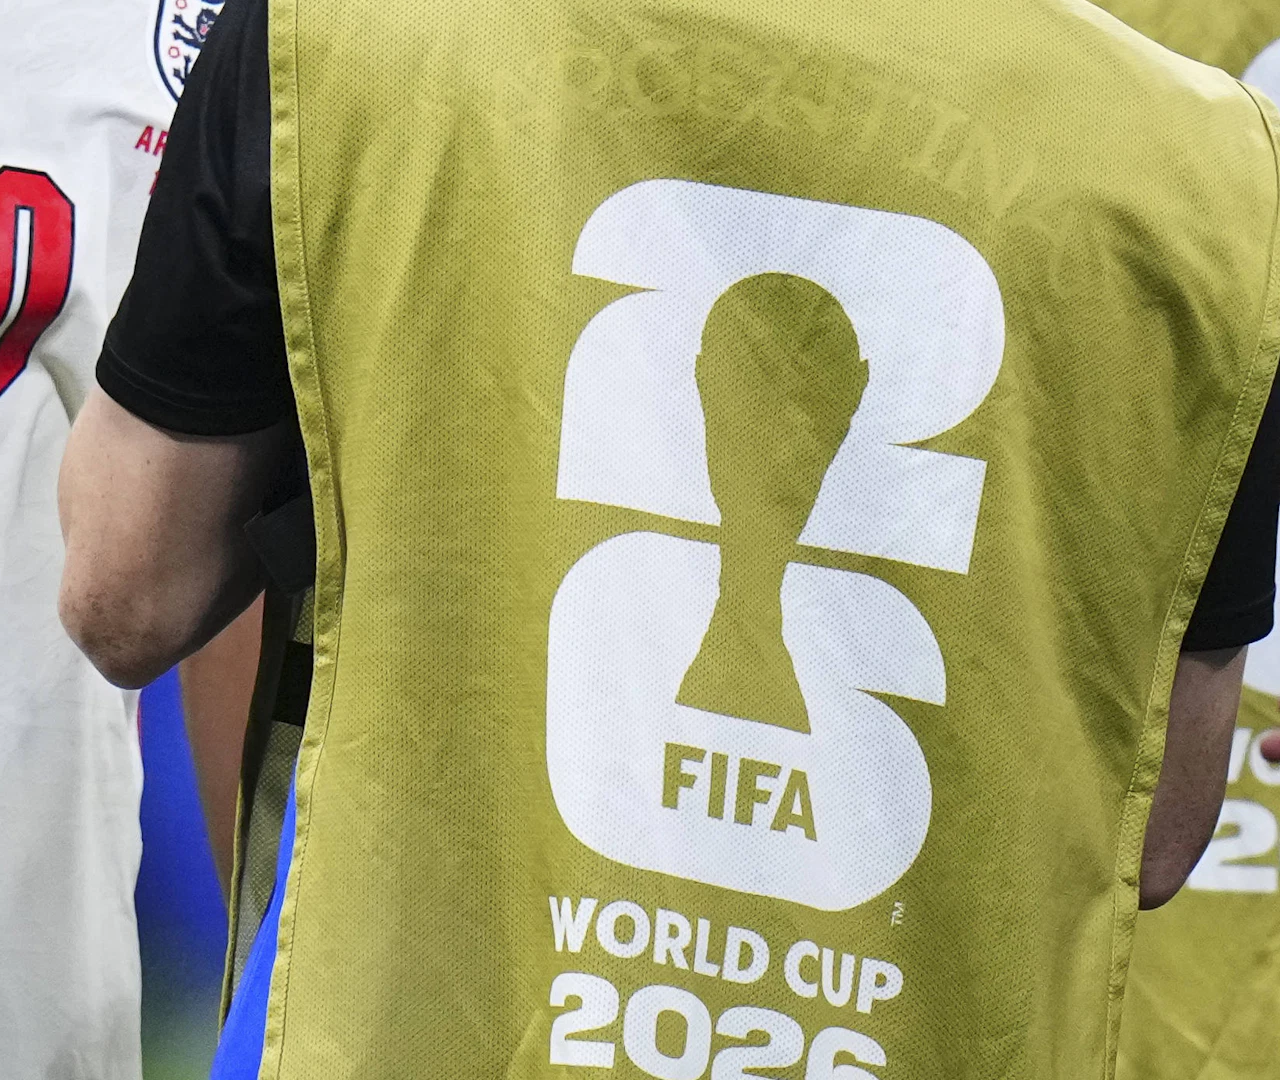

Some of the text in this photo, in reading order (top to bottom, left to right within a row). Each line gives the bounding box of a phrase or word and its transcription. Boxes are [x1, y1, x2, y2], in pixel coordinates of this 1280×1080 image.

[661, 742, 818, 842] FIFA
[548, 895, 904, 1014] WORLD CUP
[549, 971, 888, 1080] 2026
